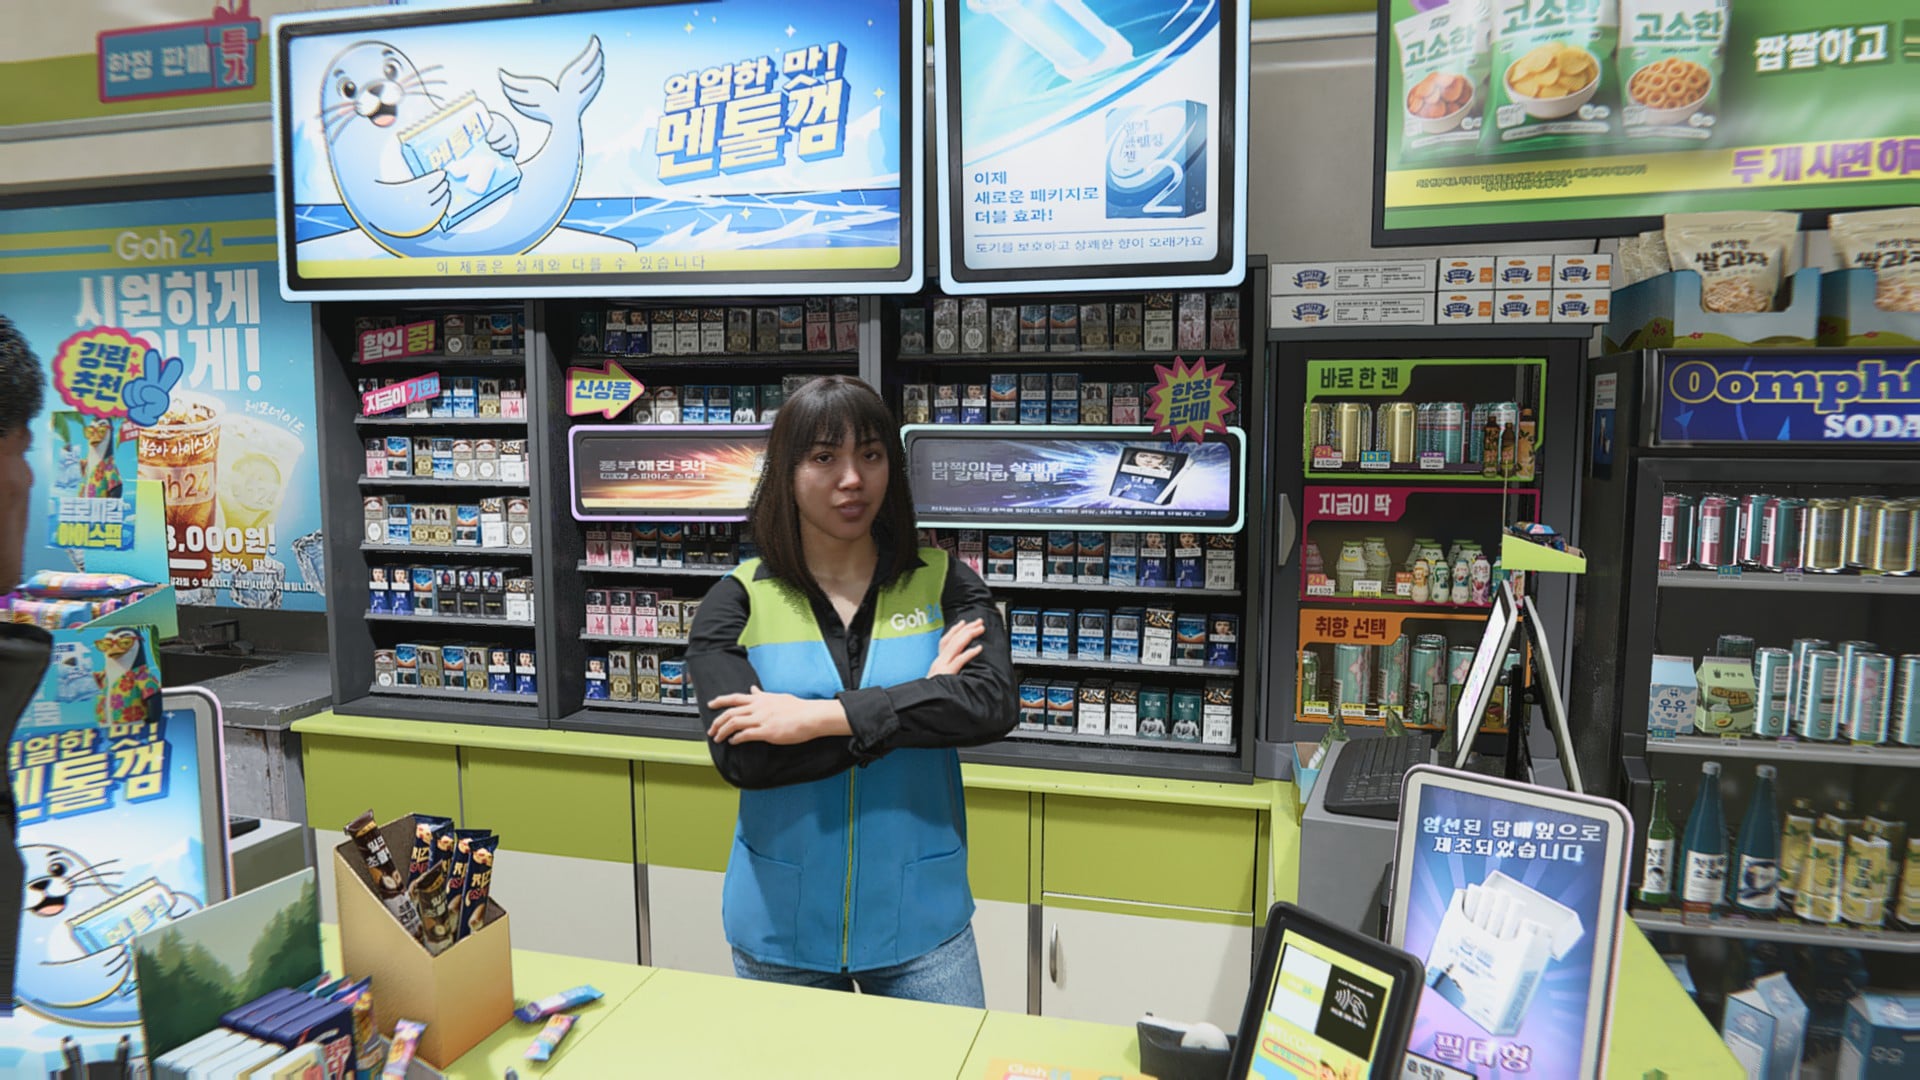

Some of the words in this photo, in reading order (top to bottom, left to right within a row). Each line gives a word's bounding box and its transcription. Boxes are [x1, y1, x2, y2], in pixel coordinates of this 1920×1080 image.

[1632, 12, 1722, 42] 고소한
[221, 27, 248, 84] 특가
[1755, 24, 1890, 73] 짭짤하고
[109, 50, 152, 82] 한정
[161, 44, 210, 77] 판매
[664, 56, 774, 113] 얼얼한
[783, 40, 849, 91] 맛!
[656, 78, 850, 185] 멘톨껌
[1732, 148, 1765, 184] 두
[1769, 147, 1802, 181] 개
[1806, 142, 1873, 178] 사면
[974, 171, 1008, 185] 이제
[974, 190, 1025, 205] 새로운
[1030, 187, 1100, 203] 패키지로
[975, 210, 1007, 225] 더블
[1013, 208, 1054, 223] 효과!
[116, 227, 215, 261] Goh24
[436, 261, 449, 274] 이
[460, 260, 504, 274] 제품은
[516, 258, 561, 273] 실제와
[572, 256, 600, 271] 다를
[614, 255, 627, 270] 수
[639, 255, 706, 271] 있습니다
[1693, 250, 1770, 273] 쌀과자
[76, 269, 261, 328] 시원하게
[78, 341, 131, 371] 강력
[363, 329, 403, 361] 할인
[407, 324, 435, 352] 중!
[70, 370, 124, 403] 추천
[575, 380, 632, 401] 신상품
[1171, 378, 1212, 404] 한정
[1321, 368, 1354, 389] 바로
[1359, 367, 1377, 389] 한
[1381, 366, 1399, 388] 캔
[365, 385, 407, 413] 지금이
[1169, 400, 1211, 427] 판매
[171, 433, 217, 455] 아이스티
[1319, 493, 1369, 516] 지금이
[1374, 493, 1392, 516] 딱
[1315, 616, 1349, 638] 취향
[1353, 617, 1387, 640] 선택
[1658, 698, 1688, 713] 우유
[1423, 815, 1482, 837] 엄선된
[1433, 836, 1585, 863] 제조되었습니다
[1434, 1031, 1533, 1073] 필터형
